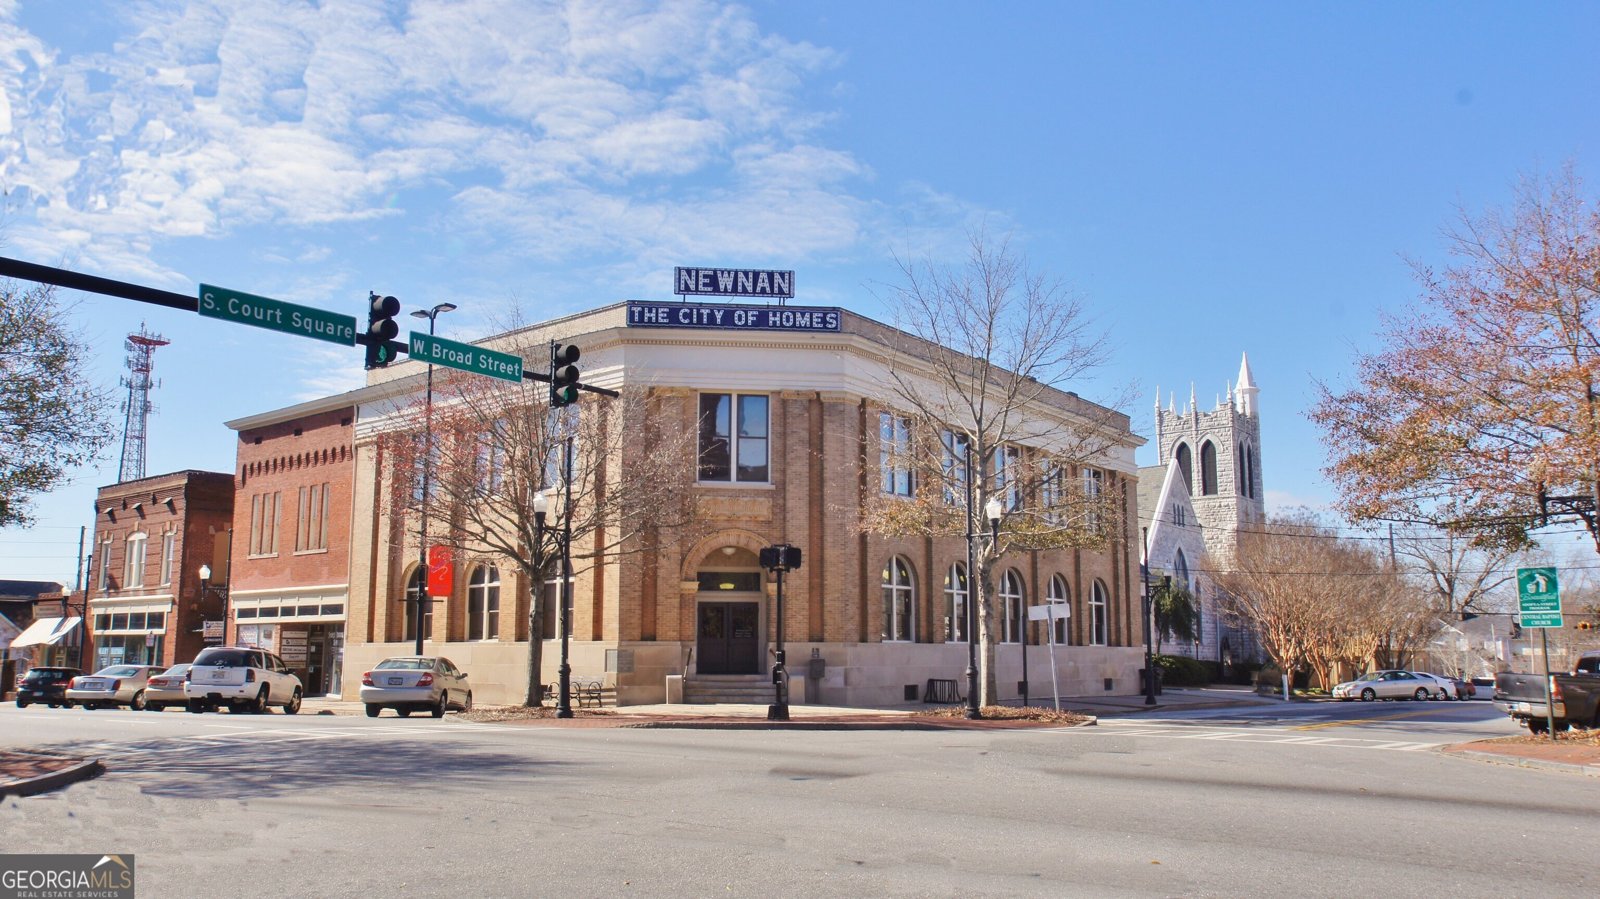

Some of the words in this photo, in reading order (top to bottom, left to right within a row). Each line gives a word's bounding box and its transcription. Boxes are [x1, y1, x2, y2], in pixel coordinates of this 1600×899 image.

[680, 269, 790, 294] NEWNAN
[203, 293, 221, 311] S.
[228, 298, 283, 324] Court
[291, 312, 353, 338] Square
[631, 306, 669, 323] THE
[679, 308, 725, 325] CITY
[734, 310, 759, 326] OF
[768, 311, 838, 328] HOMES
[413, 338, 427, 355] W.
[432, 343, 472, 365] Broad
[479, 355, 520, 376] Street
